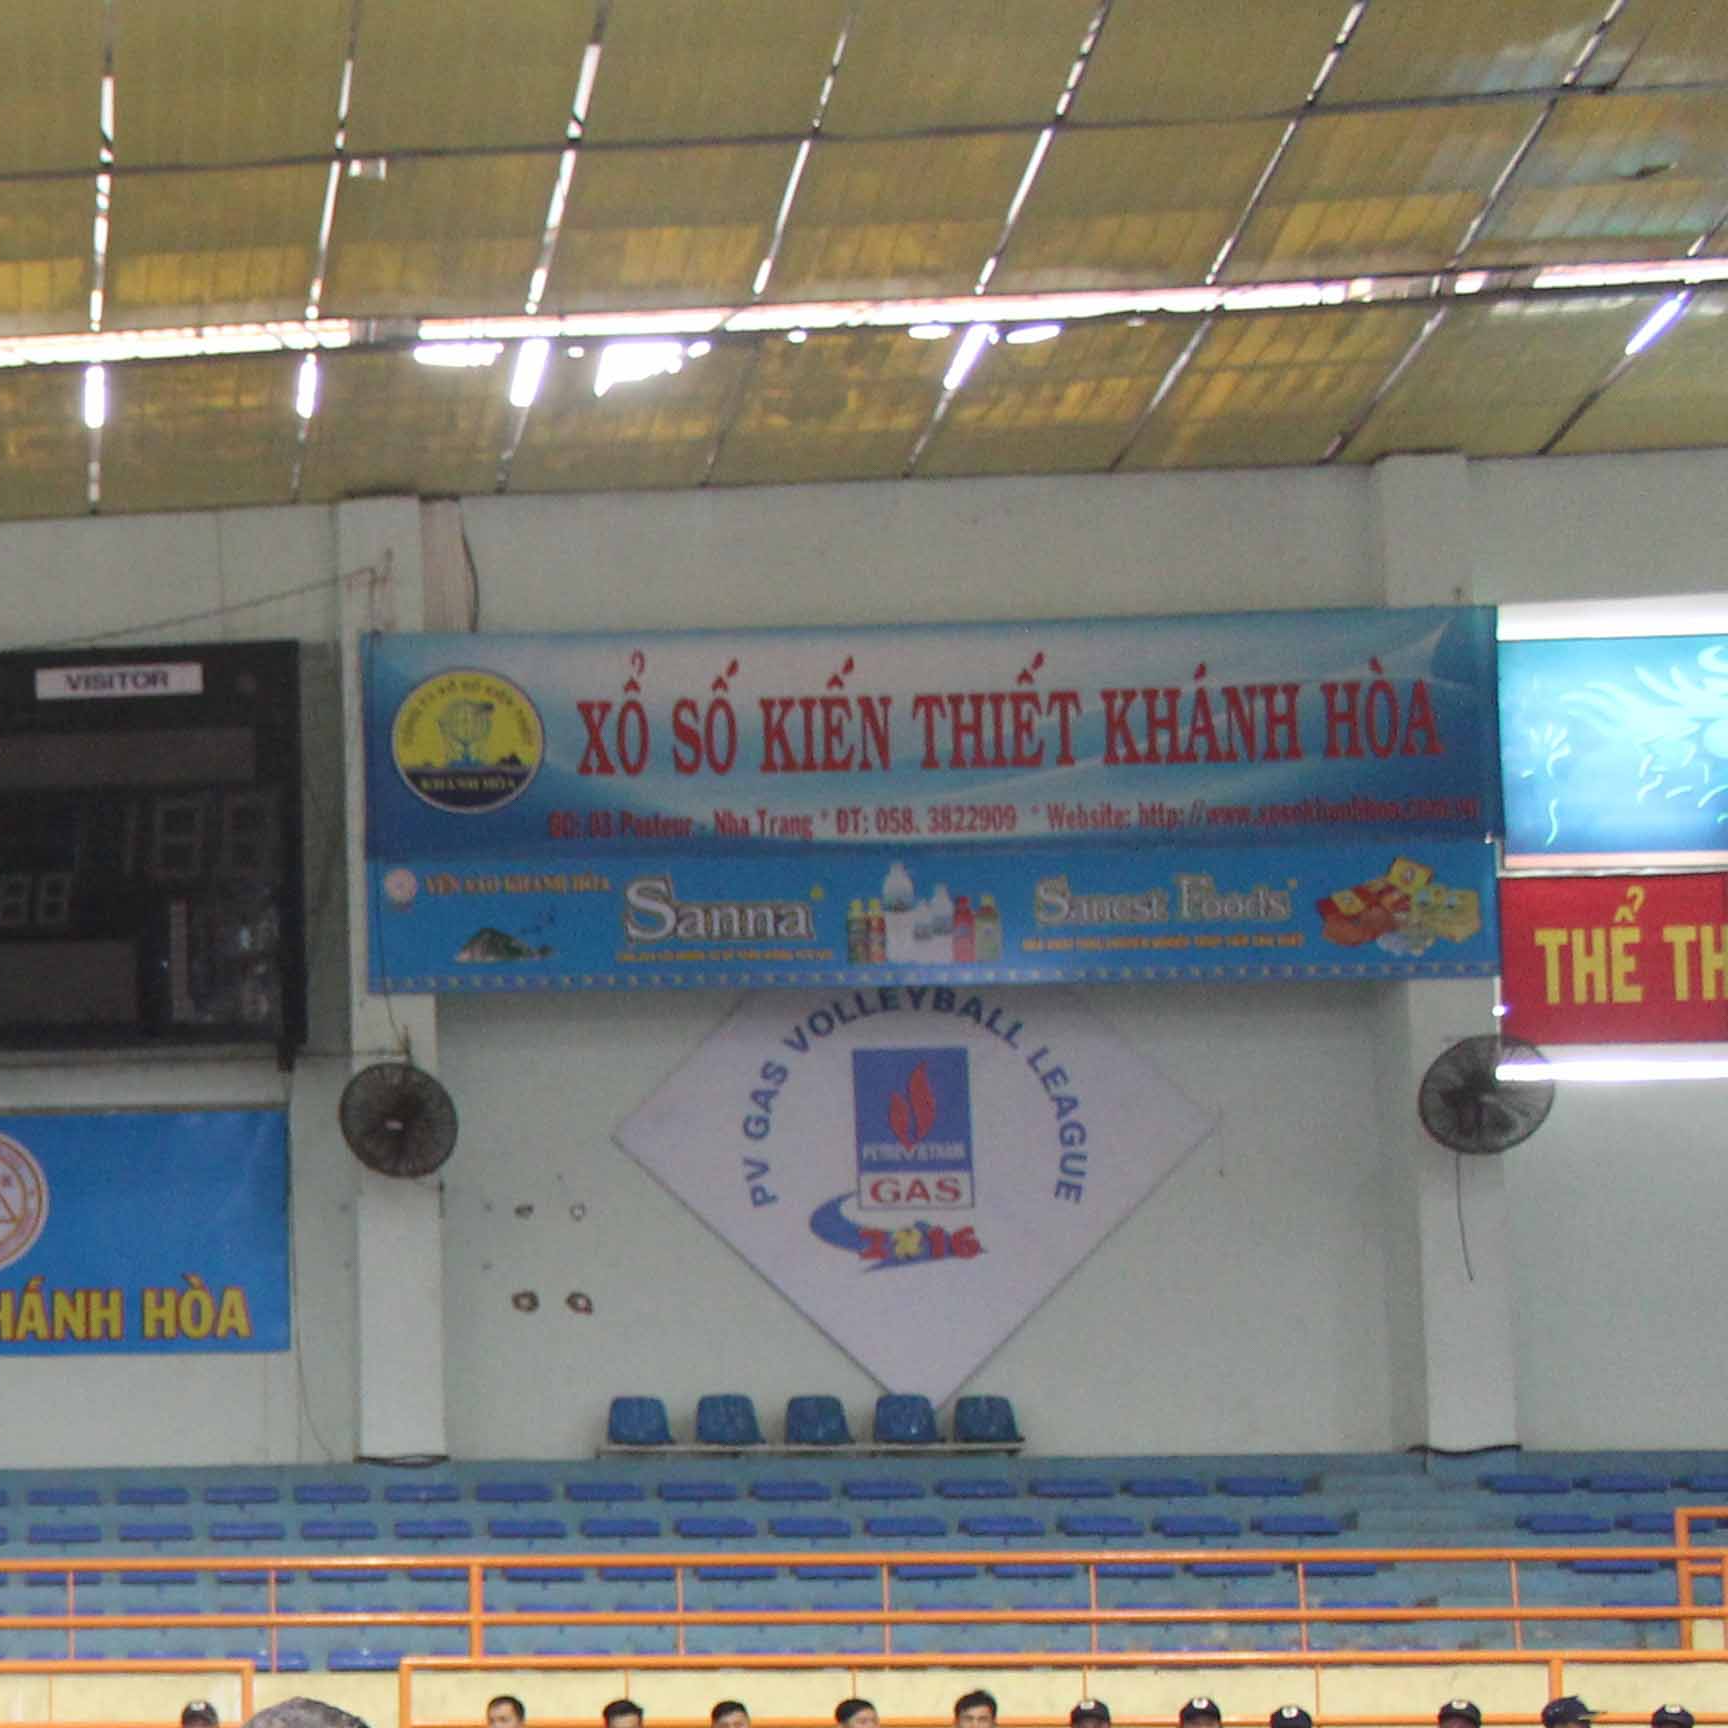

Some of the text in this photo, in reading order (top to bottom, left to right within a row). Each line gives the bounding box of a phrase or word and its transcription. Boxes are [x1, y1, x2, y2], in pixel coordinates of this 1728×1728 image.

[65, 667, 169, 692] VISITOR
[576, 650, 650, 776] XỔ
[671, 658, 740, 775] SỐ
[758, 656, 893, 773] KIẾN
[912, 652, 1080, 770] THIẾT
[1101, 662, 1304, 766] KHÁNH
[1320, 656, 1444, 759] HÒA
[714, 809, 749, 834] Nha
[756, 807, 814, 840] Trang
[1047, 801, 1133, 829] Website:
[622, 876, 818, 944] Sanna
[1034, 873, 1294, 927] Sanest Foods
[1535, 886, 1643, 1005] THỂ
[744, 1061, 789, 1140] GAS
[1028, 1047, 1088, 1204] LEAGUE
[744, 1157, 776, 1207] PV
[869, 1176, 962, 1205] GAS
[144, 1274, 252, 1339] HÒA
